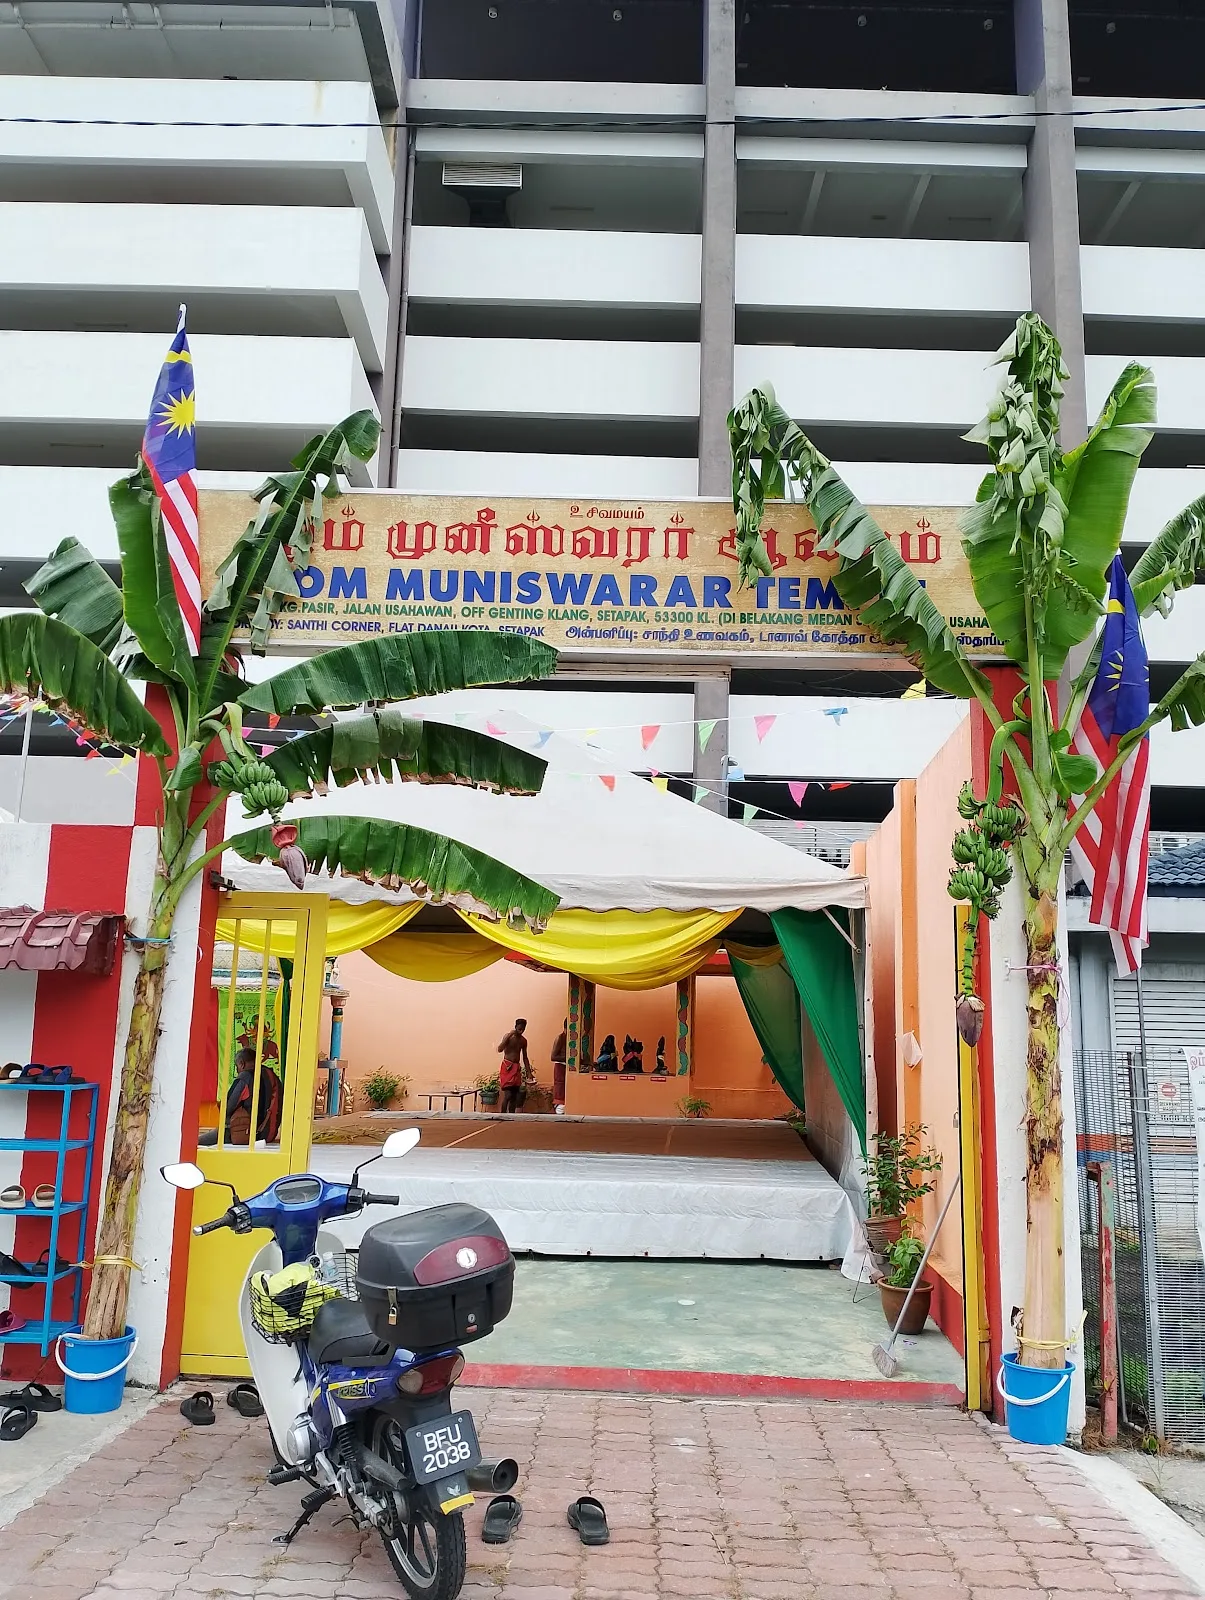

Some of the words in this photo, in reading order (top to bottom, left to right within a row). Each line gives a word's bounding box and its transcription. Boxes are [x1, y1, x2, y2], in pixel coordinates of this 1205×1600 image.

[586, 506, 645, 519] சிவமயம்
[385, 507, 697, 568] முனீஸ்வரர்
[294, 565, 368, 599] OM
[385, 568, 733, 608] MUNISWARAR
[287, 619, 327, 631] SANTHI
[331, 620, 384, 633] CORNER,
[389, 623, 415, 633] FLAT
[342, 603, 381, 616] JALAN
[385, 604, 456, 618] USAHAWAN,
[461, 606, 485, 618] OFF
[488, 607, 544, 620] GENTING
[547, 609, 593, 622] KLANG,
[597, 610, 650, 624] SETAPAK,
[654, 611, 694, 623] 53300
[697, 612, 715, 623] KL.
[718, 612, 736, 627] (DI
[739, 613, 804, 625] BELAKANG
[807, 614, 852, 626] MEDAN
[949, 616, 990, 628] USAHA
[642, 627, 680, 643] சாந்தி
[811, 630, 866, 645] கோத்தா
[423, 1423, 462, 1452] BFU
[423, 1441, 471, 1474] 2038
